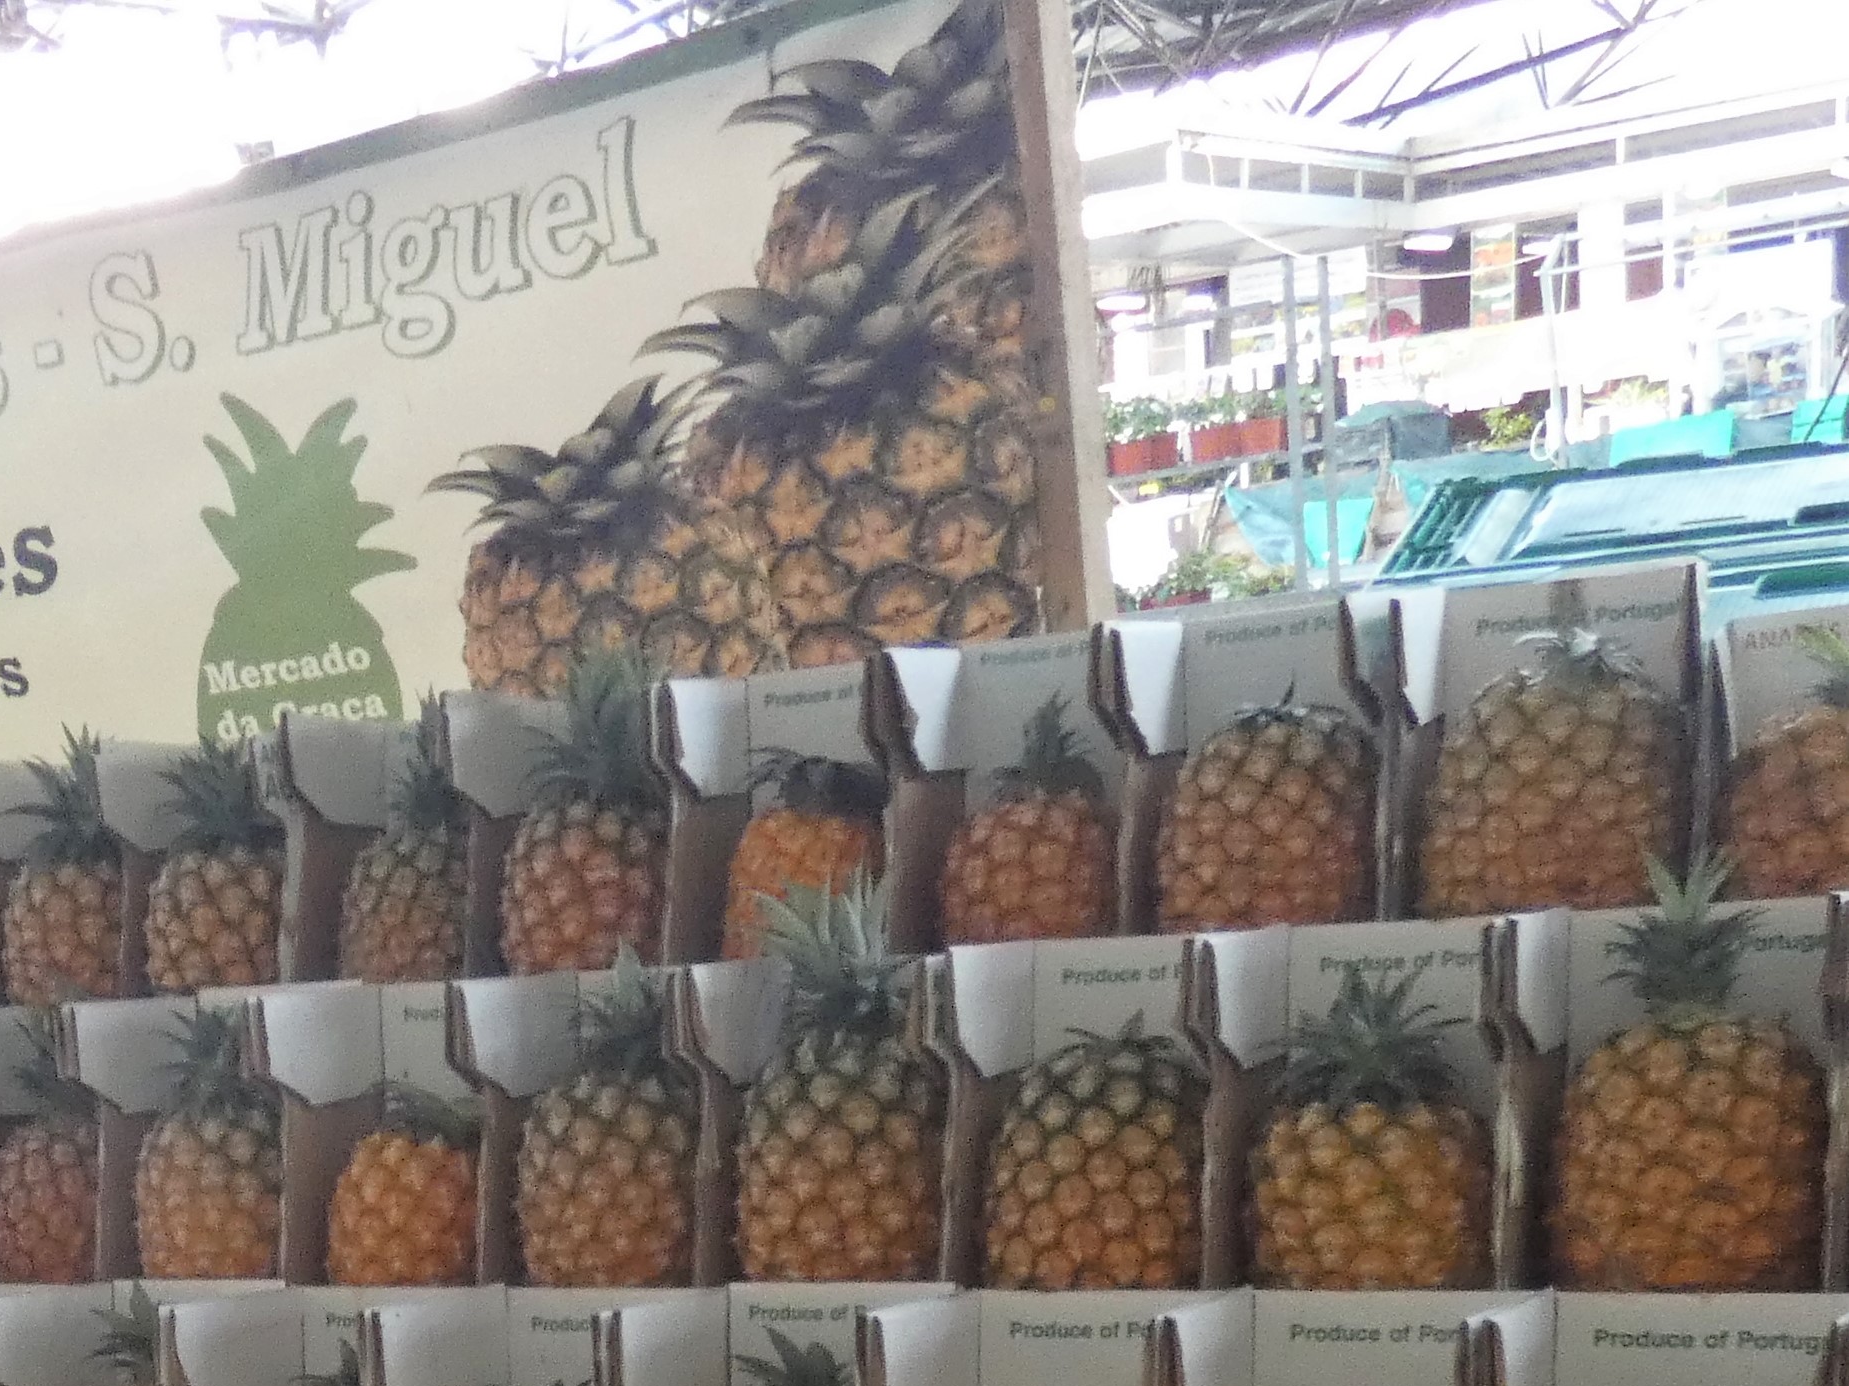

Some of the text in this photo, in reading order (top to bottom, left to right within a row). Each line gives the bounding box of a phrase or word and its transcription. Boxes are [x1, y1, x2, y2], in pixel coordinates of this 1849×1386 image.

[87, 249, 198, 387] S.
[236, 116, 659, 360] Miguel
[203, 640, 371, 694] Mercado
[216, 709, 260, 743] da
[1062, 969, 1141, 985] Produce
[748, 1304, 824, 1323] Produce
[1010, 1321, 1092, 1340] Produce
[1100, 1320, 1120, 1339] of
[1290, 1323, 1381, 1343] Produce
[1389, 1324, 1410, 1343] of
[1593, 1328, 1694, 1348] Produce
[1703, 1329, 1730, 1348] of
